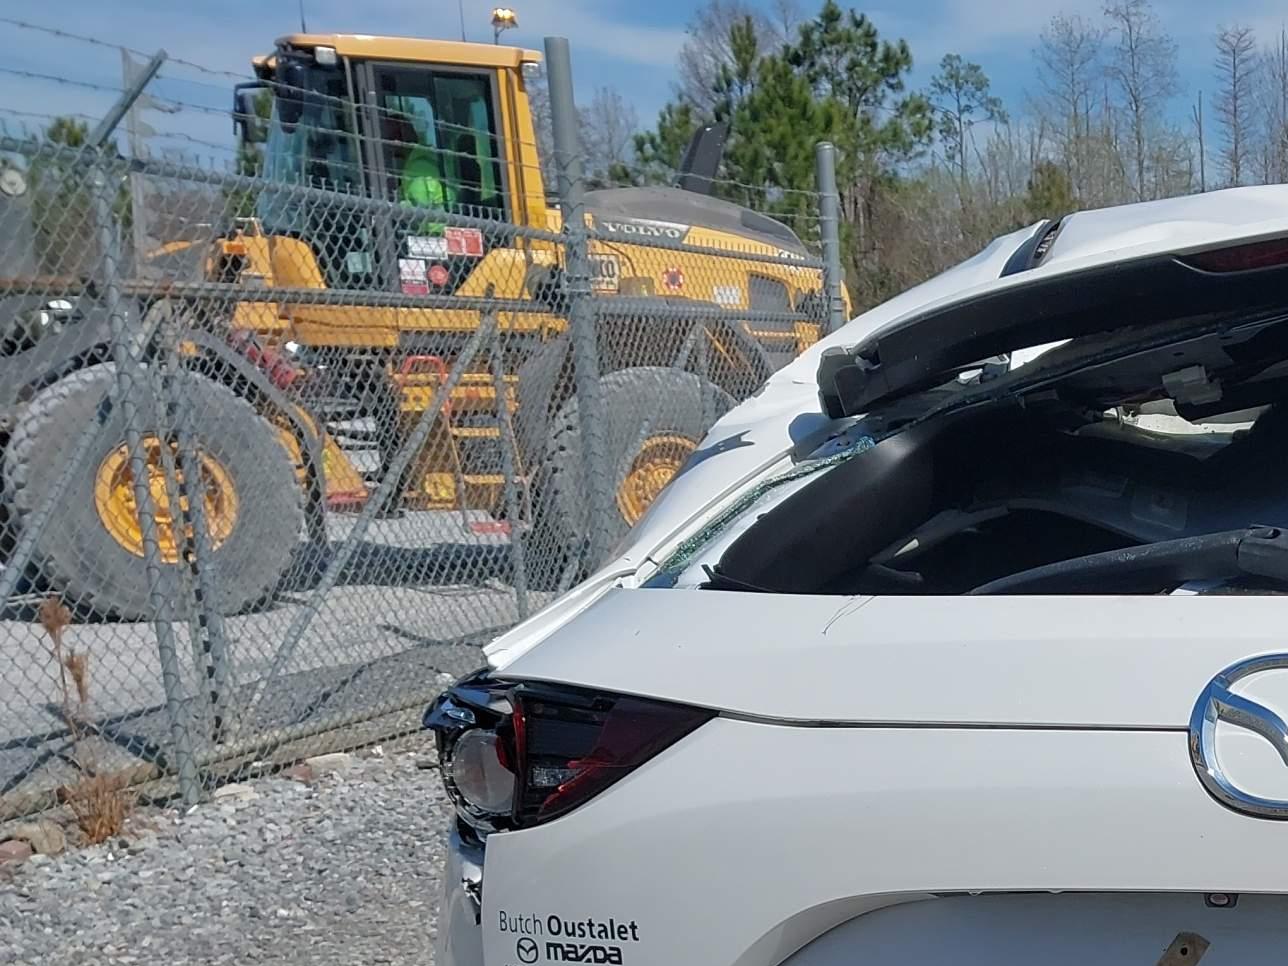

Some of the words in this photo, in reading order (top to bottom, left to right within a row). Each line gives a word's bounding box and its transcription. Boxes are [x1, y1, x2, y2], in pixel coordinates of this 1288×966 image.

[602, 222, 681, 239] VOLVO
[500, 911, 543, 935] Butch
[548, 915, 640, 941] Oustalet
